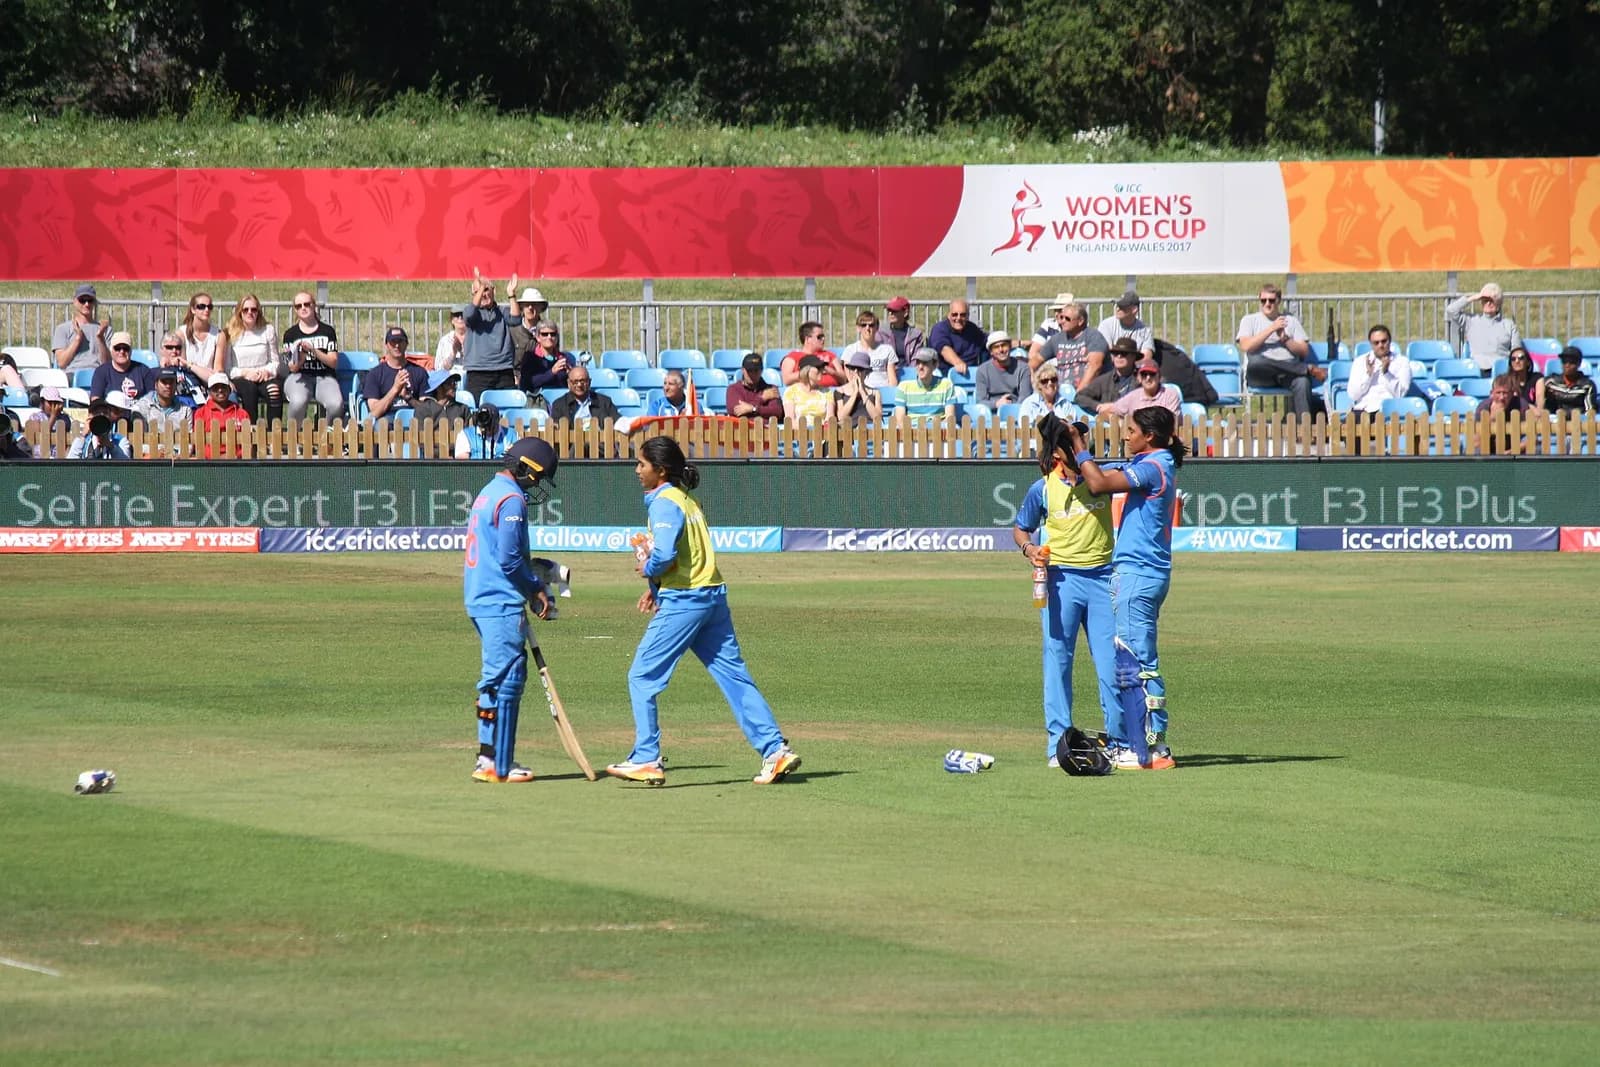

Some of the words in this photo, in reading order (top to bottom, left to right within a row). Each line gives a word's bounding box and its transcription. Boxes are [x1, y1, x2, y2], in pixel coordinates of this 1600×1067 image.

[1126, 183, 1142, 193] ICC
[1065, 194, 1192, 216] WOMEN'S
[1051, 219, 1149, 240] WORLD
[1154, 218, 1206, 239] CUP
[1065, 243, 1118, 253] ENGLAND
[1128, 242, 1165, 252] WALES
[1167, 241, 1192, 252] 2017
[17, 481, 154, 526] Selfie
[171, 484, 330, 527] Expert
[353, 490, 399, 527] F3
[1323, 487, 1368, 524] F3
[1397, 486, 1443, 524] F3
[1456, 484, 1536, 523] Plus
[0, 532, 57, 547] MRF
[62, 531, 124, 547] TYRES
[129, 531, 191, 547] MRF
[195, 531, 256, 547] TYRES
[536, 528, 604, 547] follow
[827, 530, 994, 550] icc-cricket.com
[1190, 529, 1282, 549] #WWC17
[1342, 528, 1513, 549] icc-cricket.com
